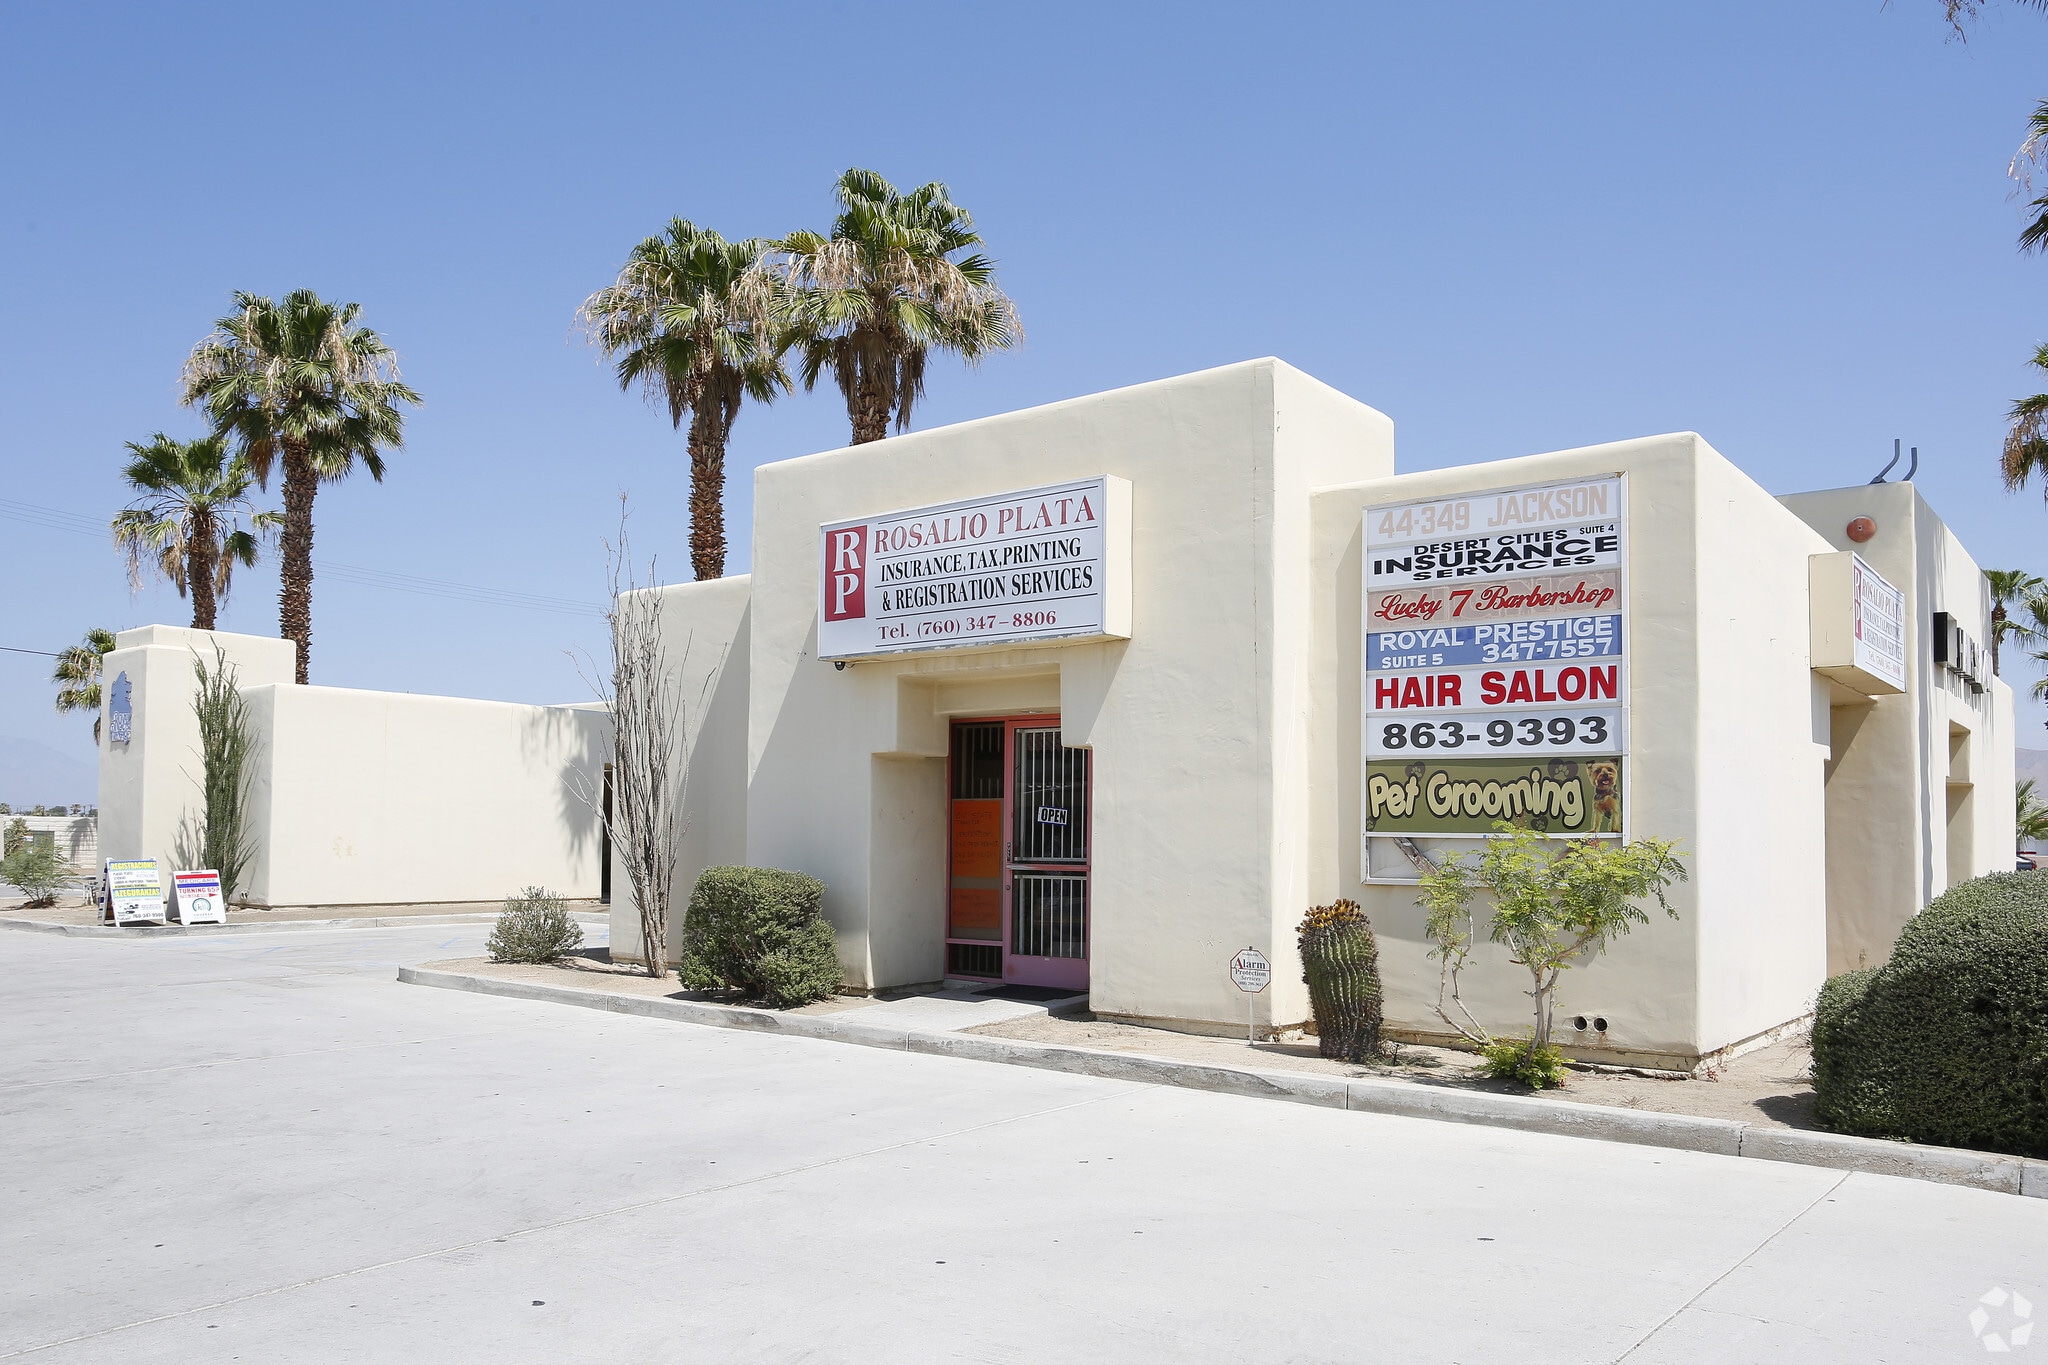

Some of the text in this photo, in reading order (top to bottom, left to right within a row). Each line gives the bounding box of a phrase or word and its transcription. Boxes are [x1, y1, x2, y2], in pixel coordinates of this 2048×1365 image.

[873, 495, 1096, 553] ROSALIO PLATA
[1379, 484, 1608, 538] 44-349 JACKSON
[1414, 529, 1568, 555] DESERT CITIES
[1579, 524, 1615, 535] SUITE 4
[833, 530, 861, 572] R
[1374, 535, 1618, 575] INSURANCE
[1413, 555, 1596, 581] SERVICES
[834, 573, 859, 615] P
[882, 566, 1093, 612] & REGISTRATION SERVICES
[1374, 582, 1615, 621] Lucky 7 Barbershop
[878, 624, 909, 640] Tel.
[917, 619, 960, 638] (760)
[1380, 616, 1613, 652] ROYAL PRESTIGE
[1381, 653, 1443, 669] SUITE 5
[1482, 638, 1612, 662] 347-7557
[1375, 665, 1617, 709] HAIR SALON
[1382, 716, 1608, 749] 863-9393
[1369, 767, 1585, 828] Pet Grooming
[1040, 808, 1067, 824] OPEN
[1234, 957, 1265, 969] Alarm
[1235, 968, 1266, 976] Protection
